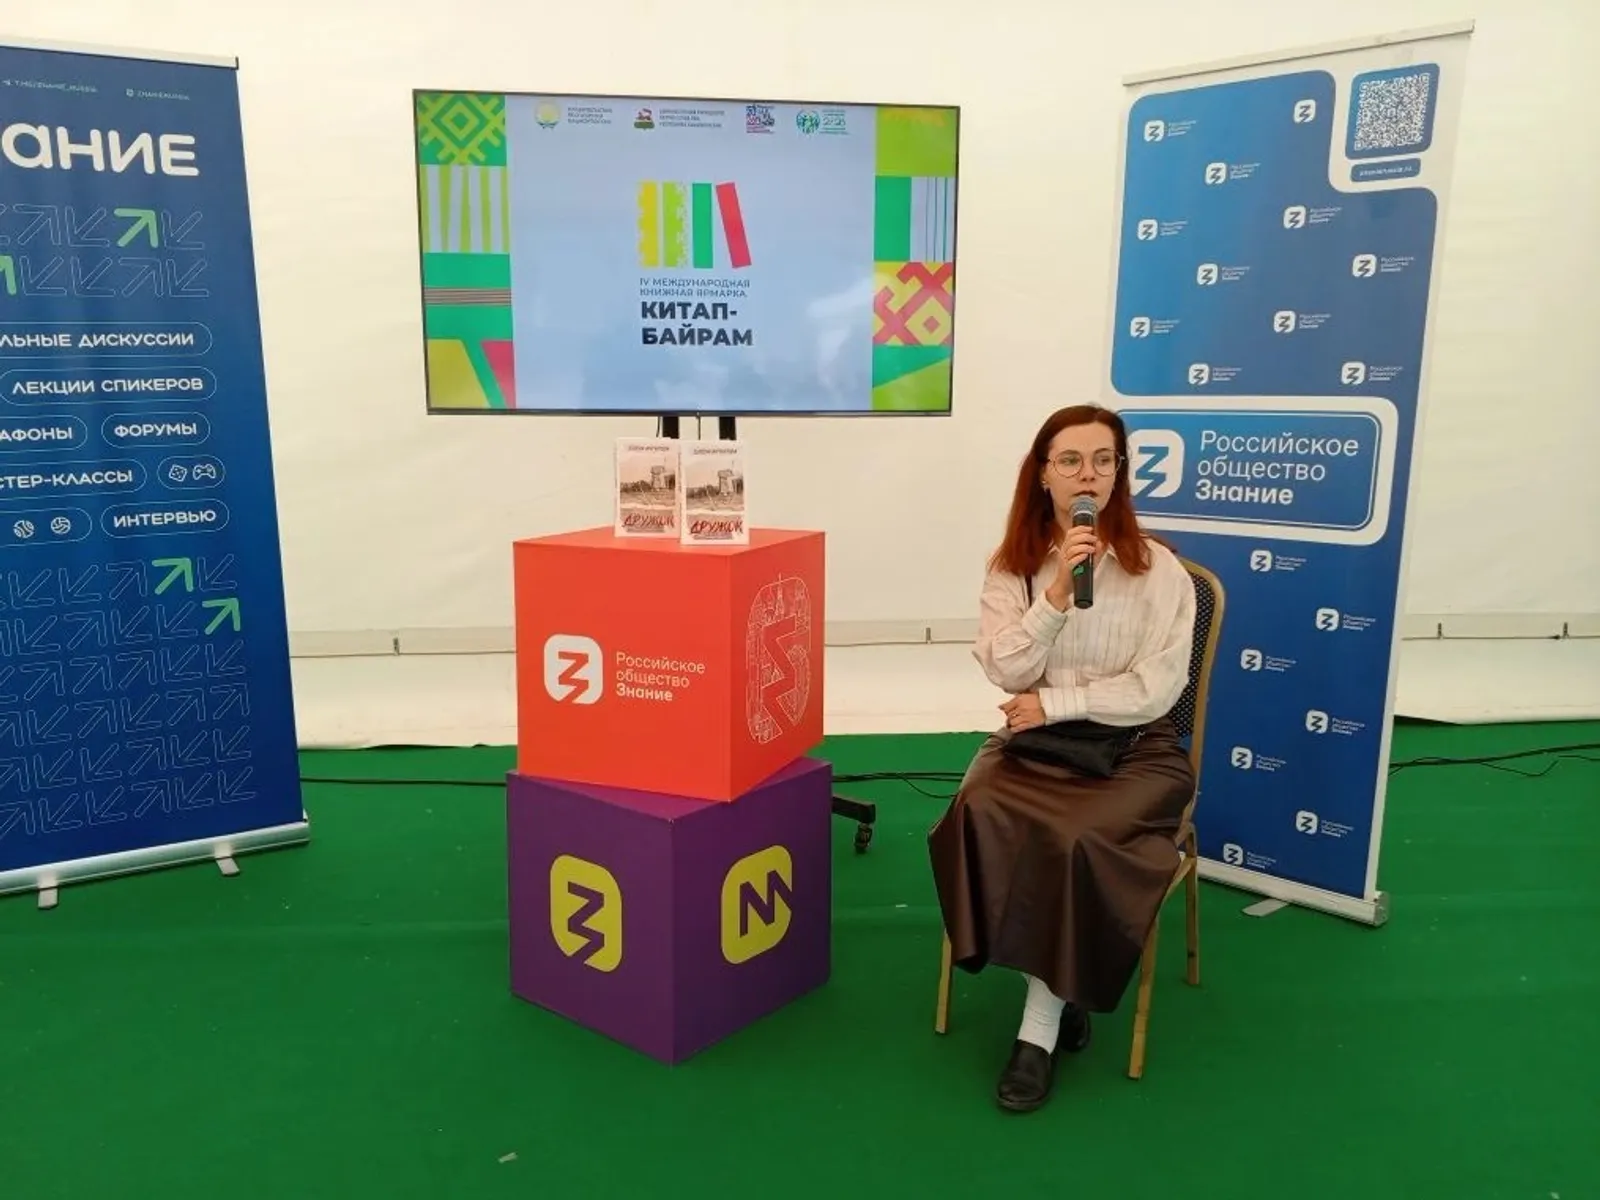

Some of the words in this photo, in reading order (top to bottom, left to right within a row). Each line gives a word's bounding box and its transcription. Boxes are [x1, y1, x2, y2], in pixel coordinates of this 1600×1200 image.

[640, 288, 693, 296] КНИЖНАЯ
[653, 278, 750, 288] МЕЖДУНАРОДНАЯ
[641, 301, 737, 320] КИТАП-
[78, 333, 194, 348] ДИСКУССИИ
[641, 323, 753, 346] БАЙРАМ
[12, 381, 95, 395] ЛЕКЦИИ
[101, 378, 204, 392] СПИКЕРОВ
[114, 423, 197, 438] ФОРУМЫ
[1201, 430, 1359, 456] Российское
[1197, 454, 1326, 481] общество
[1195, 479, 1294, 505] Знание
[113, 510, 217, 528] ИНТЕРВЬЮ
[616, 651, 705, 674] Российское
[616, 668, 690, 688] общество
[616, 682, 673, 701] Знание
